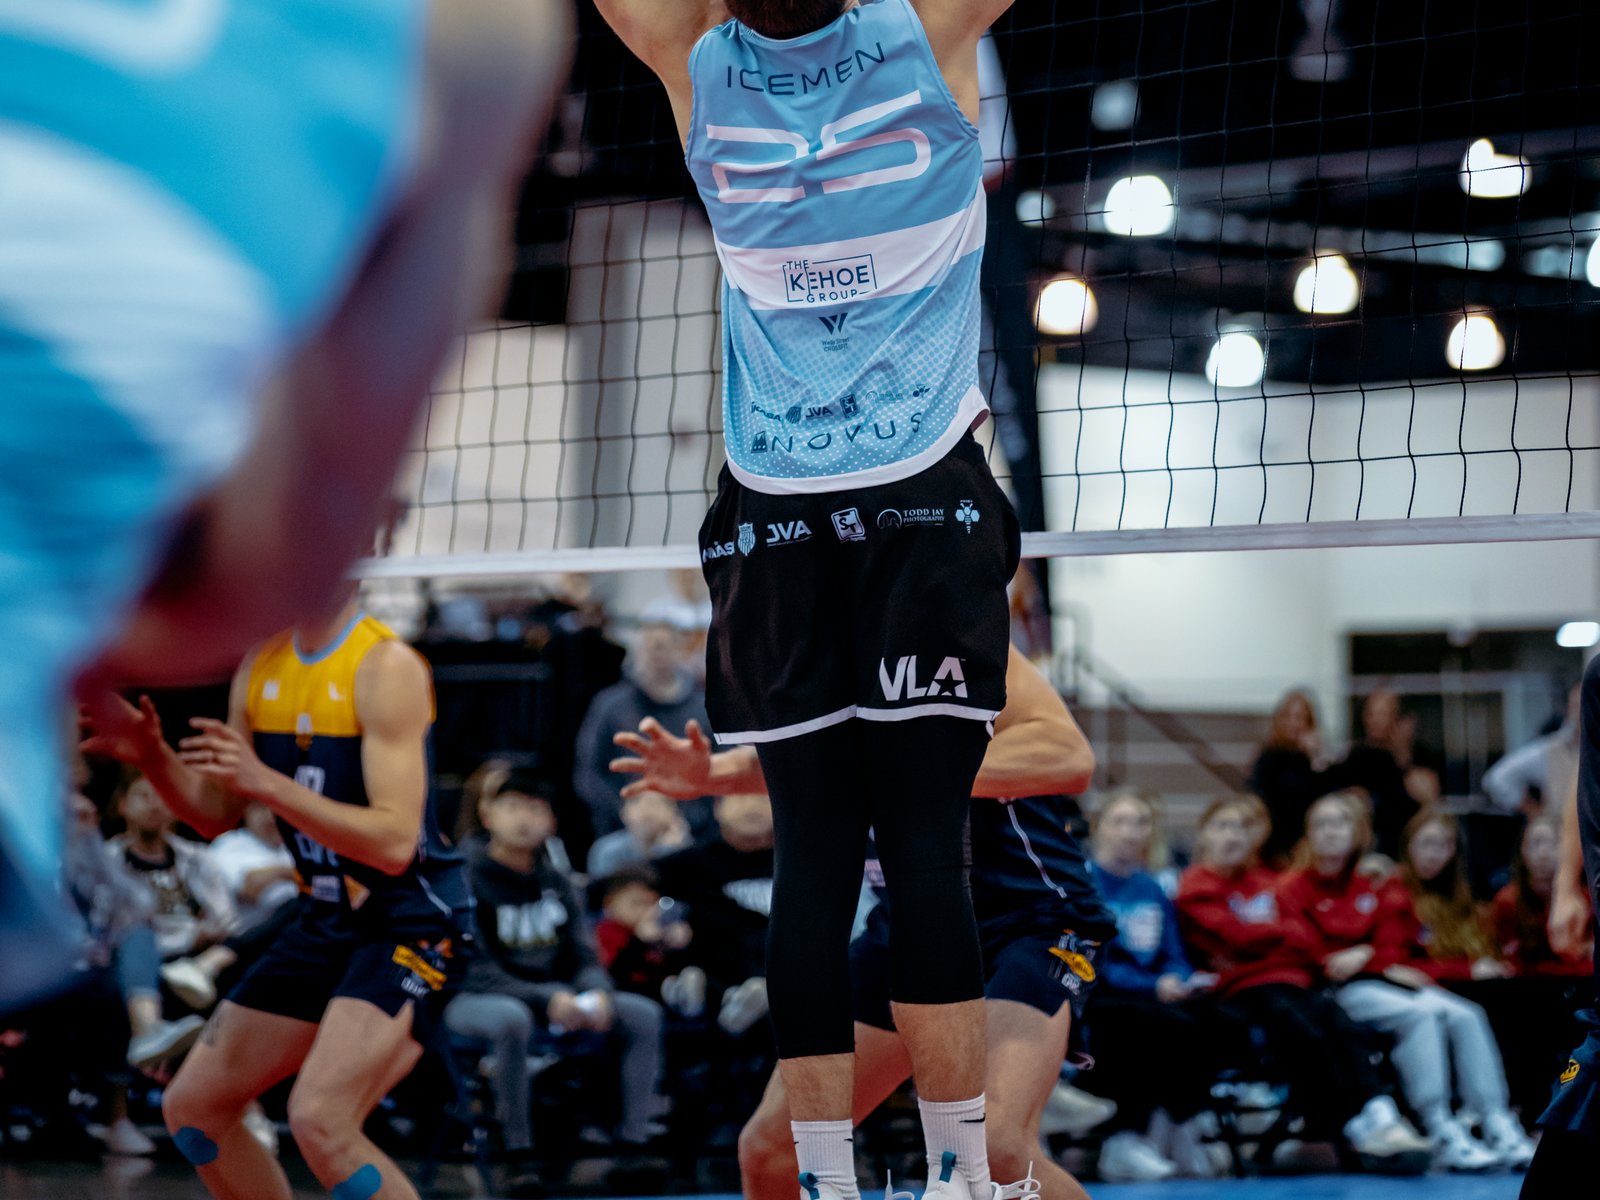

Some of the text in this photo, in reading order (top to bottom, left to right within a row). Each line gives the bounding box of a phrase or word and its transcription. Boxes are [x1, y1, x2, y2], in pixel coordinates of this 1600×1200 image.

[727, 42, 885, 96] ICEMEN
[706, 89, 932, 204] 25
[786, 259, 809, 271] THE
[790, 264, 870, 292] KEHOE
[806, 289, 858, 304] GROUP
[771, 412, 922, 453] NOVUS
[902, 508, 945, 517] TODD JAY
[766, 520, 812, 544] JVA
[878, 655, 968, 701] VLA
